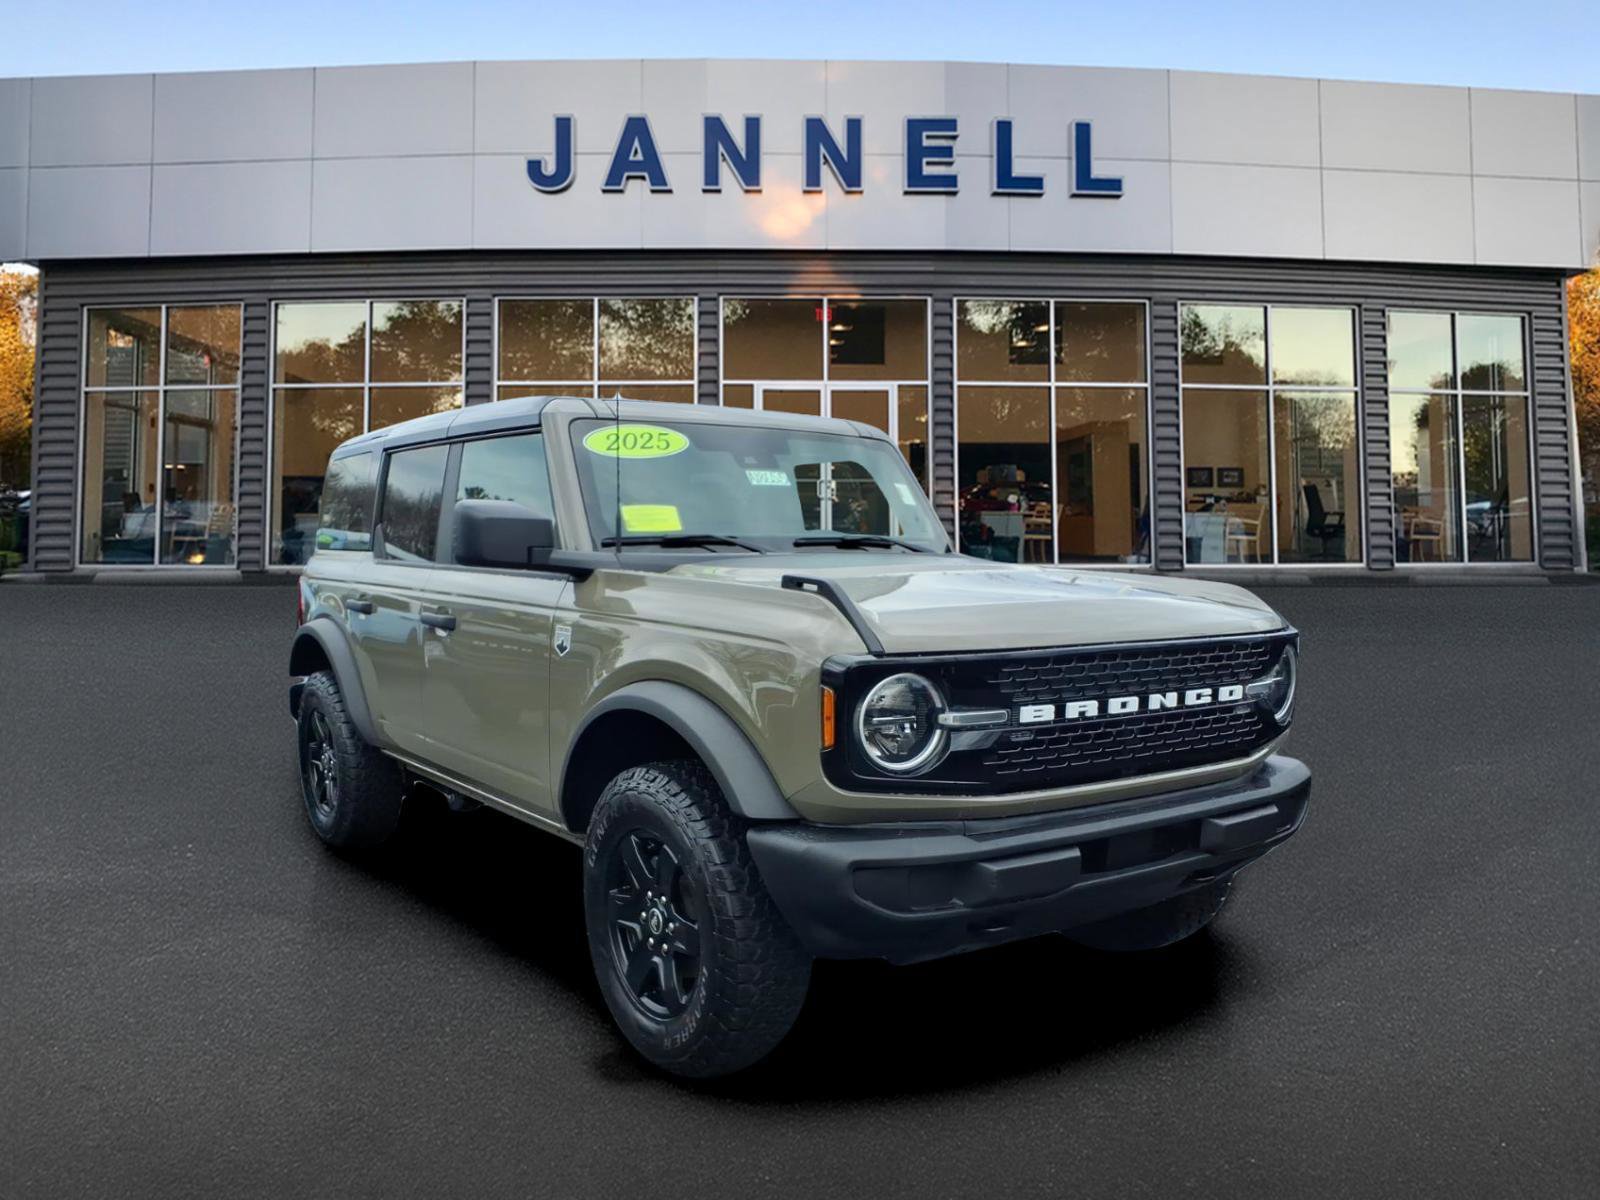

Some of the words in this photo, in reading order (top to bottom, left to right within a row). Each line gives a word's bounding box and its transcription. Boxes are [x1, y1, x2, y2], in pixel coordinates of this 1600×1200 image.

[526, 113, 1124, 198] JANNELL
[606, 432, 670, 451] 2025
[1019, 685, 1243, 724] BRONCO
